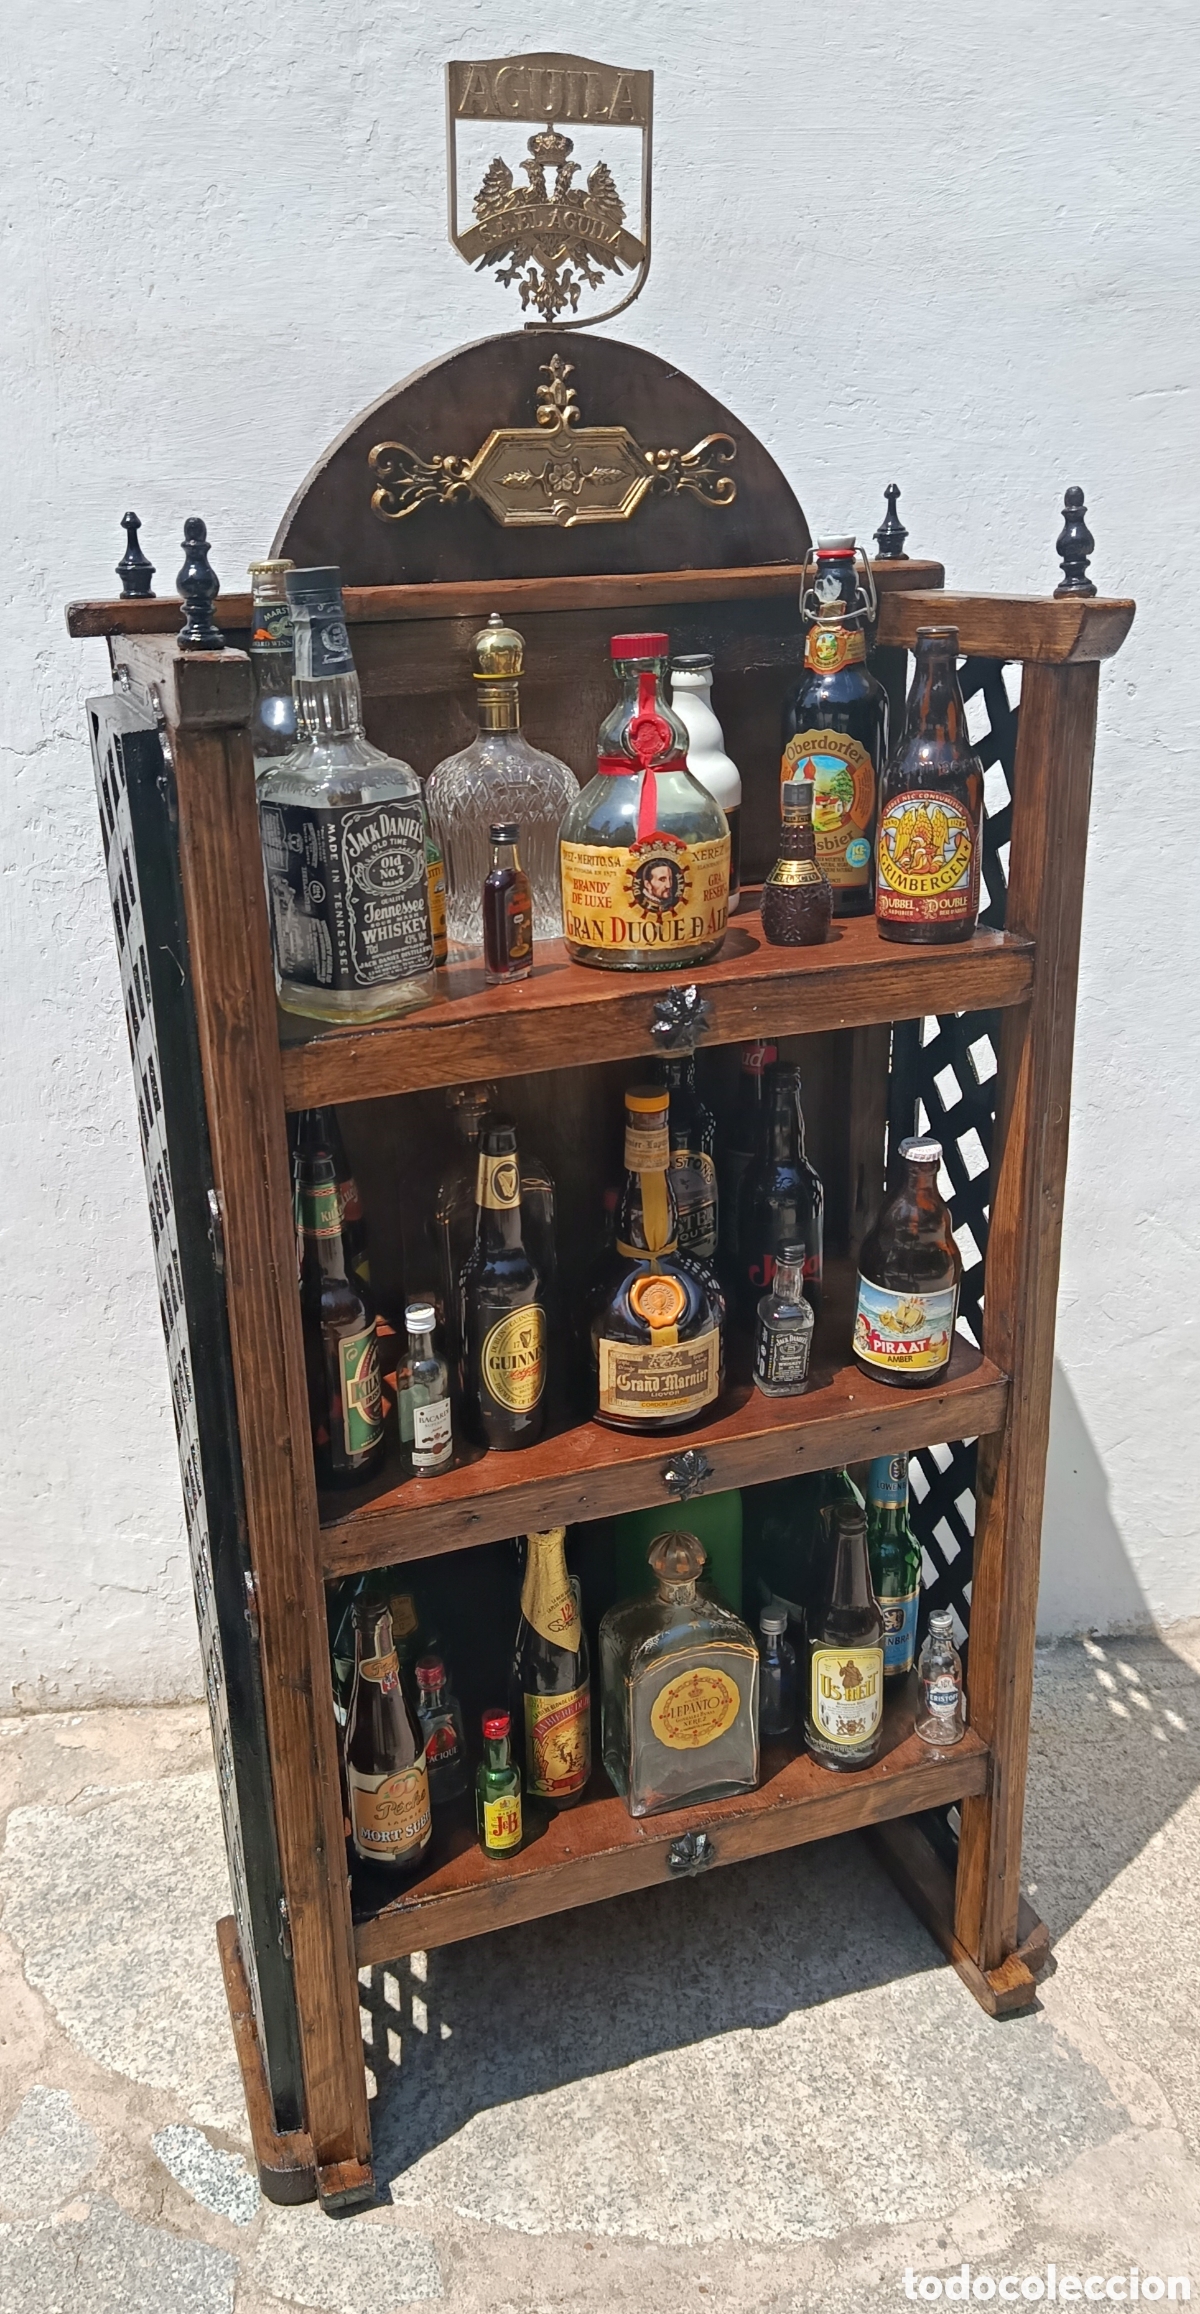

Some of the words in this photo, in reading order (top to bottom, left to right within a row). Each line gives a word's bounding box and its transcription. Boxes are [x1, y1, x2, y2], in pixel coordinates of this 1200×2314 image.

[458, 63, 646, 121] AGUILA
[548, 208, 622, 249] AGUILA
[786, 735, 865, 765] Oberdorfer
[327, 823, 339, 861] MADE
[347, 822, 381, 857] JACK
[371, 840, 388, 852] OLD
[389, 838, 408, 846] TIME
[816, 830, 856, 851] sbier
[380, 855, 402, 869] Old
[692, 845, 724, 862] XEREZ
[331, 869, 341, 883] IN
[379, 865, 405, 880] No.7
[881, 853, 968, 892] GRIMBERGEN
[572, 878, 611, 895] BRANDY
[380, 894, 405, 905] QUALITY
[571, 892, 583, 906] DE
[584, 894, 612, 909] LUXE
[879, 896, 915, 917] DUBBEL
[922, 896, 968, 920] DOUBLE
[363, 898, 425, 924] Tennessee
[333, 892, 350, 975] TENNESSEE
[361, 915, 428, 945] WHISKEY
[566, 909, 606, 942] GRAN
[609, 916, 686, 946] DUQUE
[365, 943, 379, 956] 70cl
[358, 960, 378, 970] JACK
[742, 1048, 766, 1067] ud
[675, 1156, 714, 1185] STON'S
[680, 1224, 713, 1241] OUT
[489, 1345, 545, 1370] GUINNE
[873, 1340, 927, 1354] PIRAAT
[887, 1355, 913, 1363] AMBER
[616, 1373, 660, 1392] Grand
[647, 1369, 709, 1391] Marnier
[670, 1696, 720, 1719] LEPANTO
[360, 1826, 404, 1842] MORT
[492, 1811, 518, 1837] J&B
